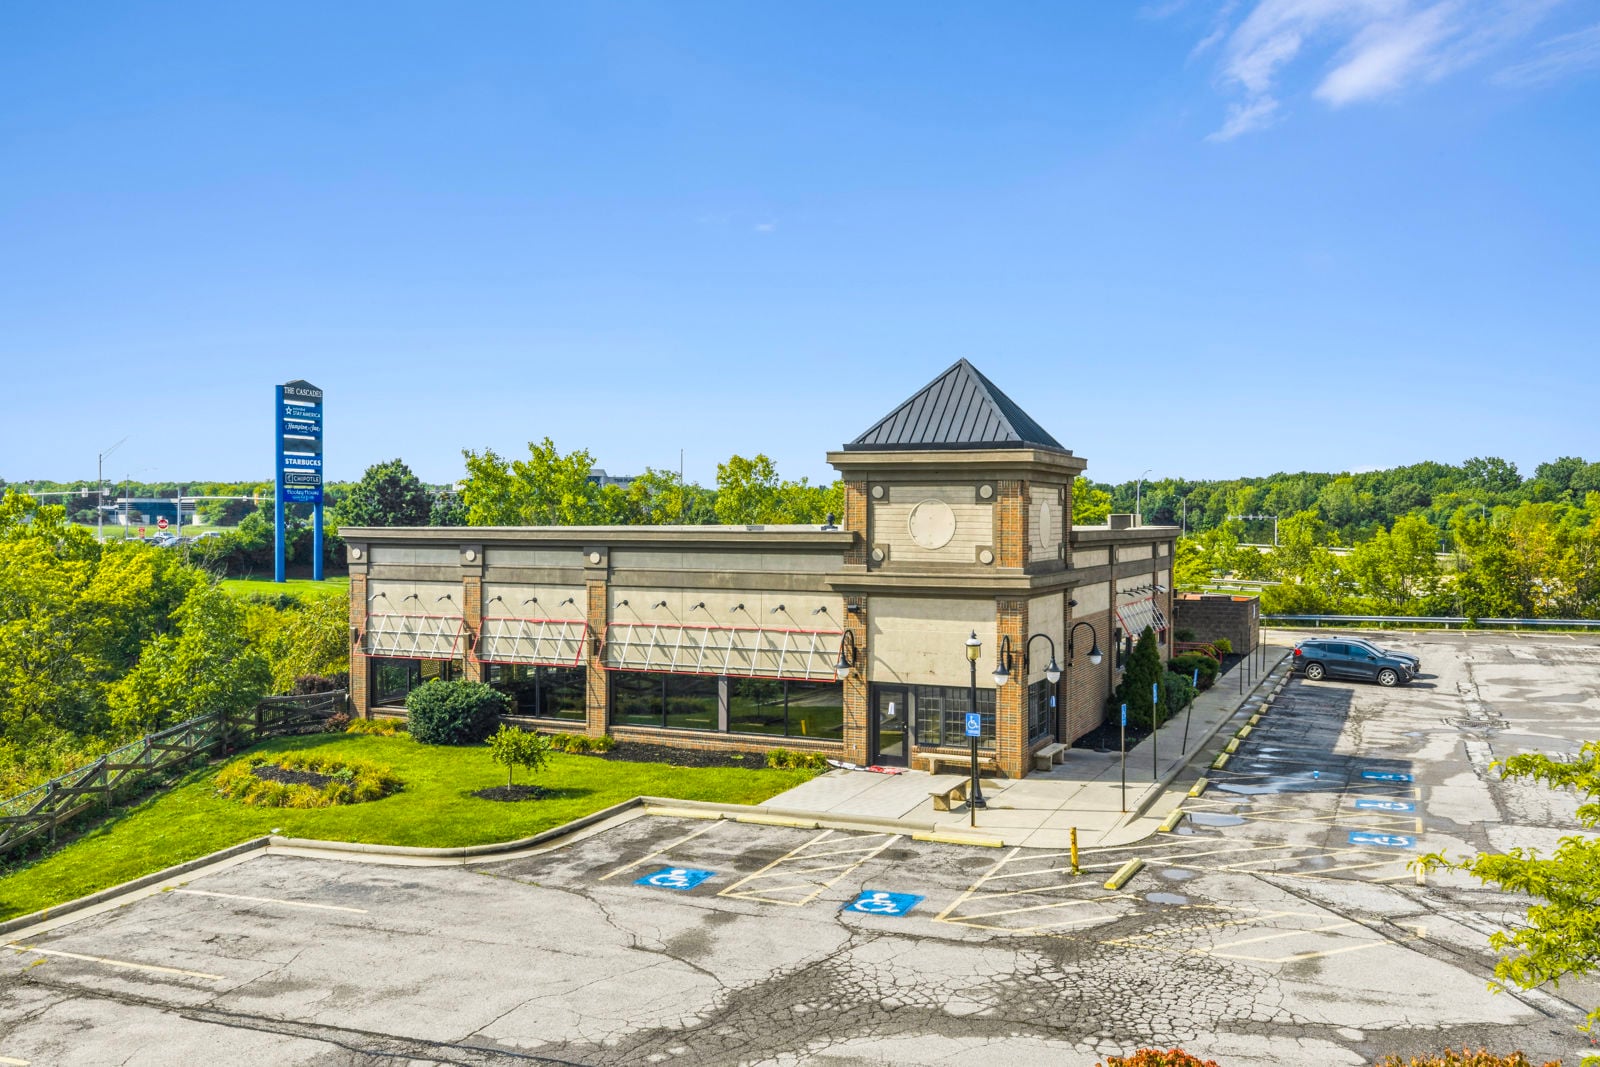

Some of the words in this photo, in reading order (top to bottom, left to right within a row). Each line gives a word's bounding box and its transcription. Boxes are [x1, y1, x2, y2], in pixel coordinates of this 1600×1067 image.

[284, 387, 295, 395] THE
[296, 388, 322, 398] CASCADES
[285, 458, 321, 466] STARBUCKS
